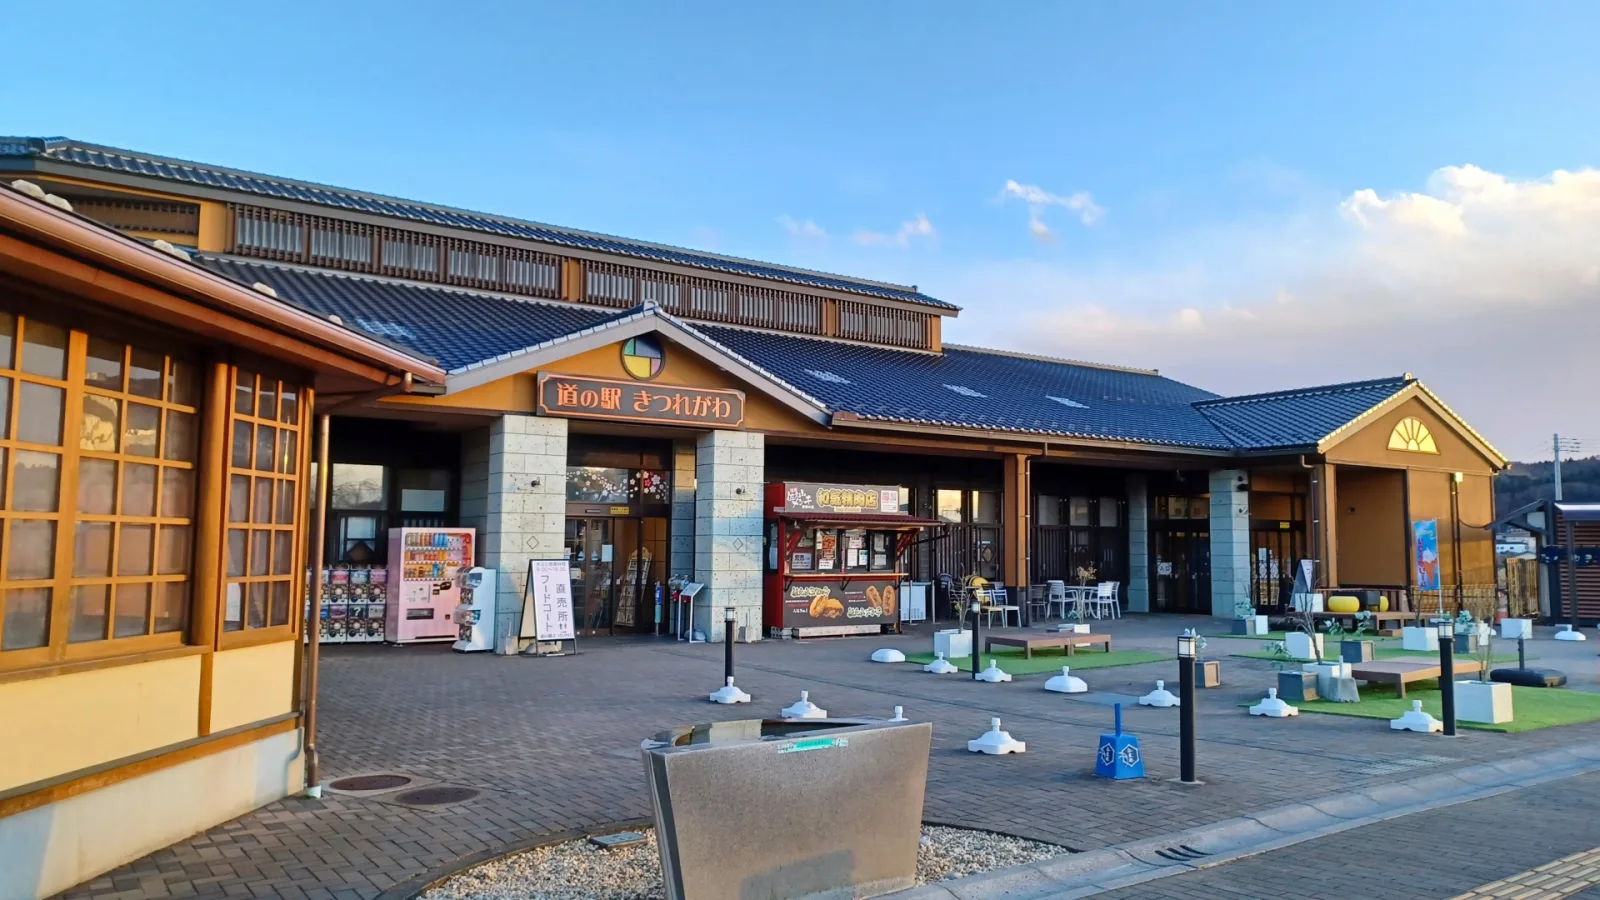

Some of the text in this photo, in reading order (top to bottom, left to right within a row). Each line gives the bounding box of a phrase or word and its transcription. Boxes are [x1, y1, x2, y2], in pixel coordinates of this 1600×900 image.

[556, 383, 731, 417] 道の駅 きつれがわ
[541, 575, 553, 632] フードコート
[556, 583, 568, 621] 直売所
